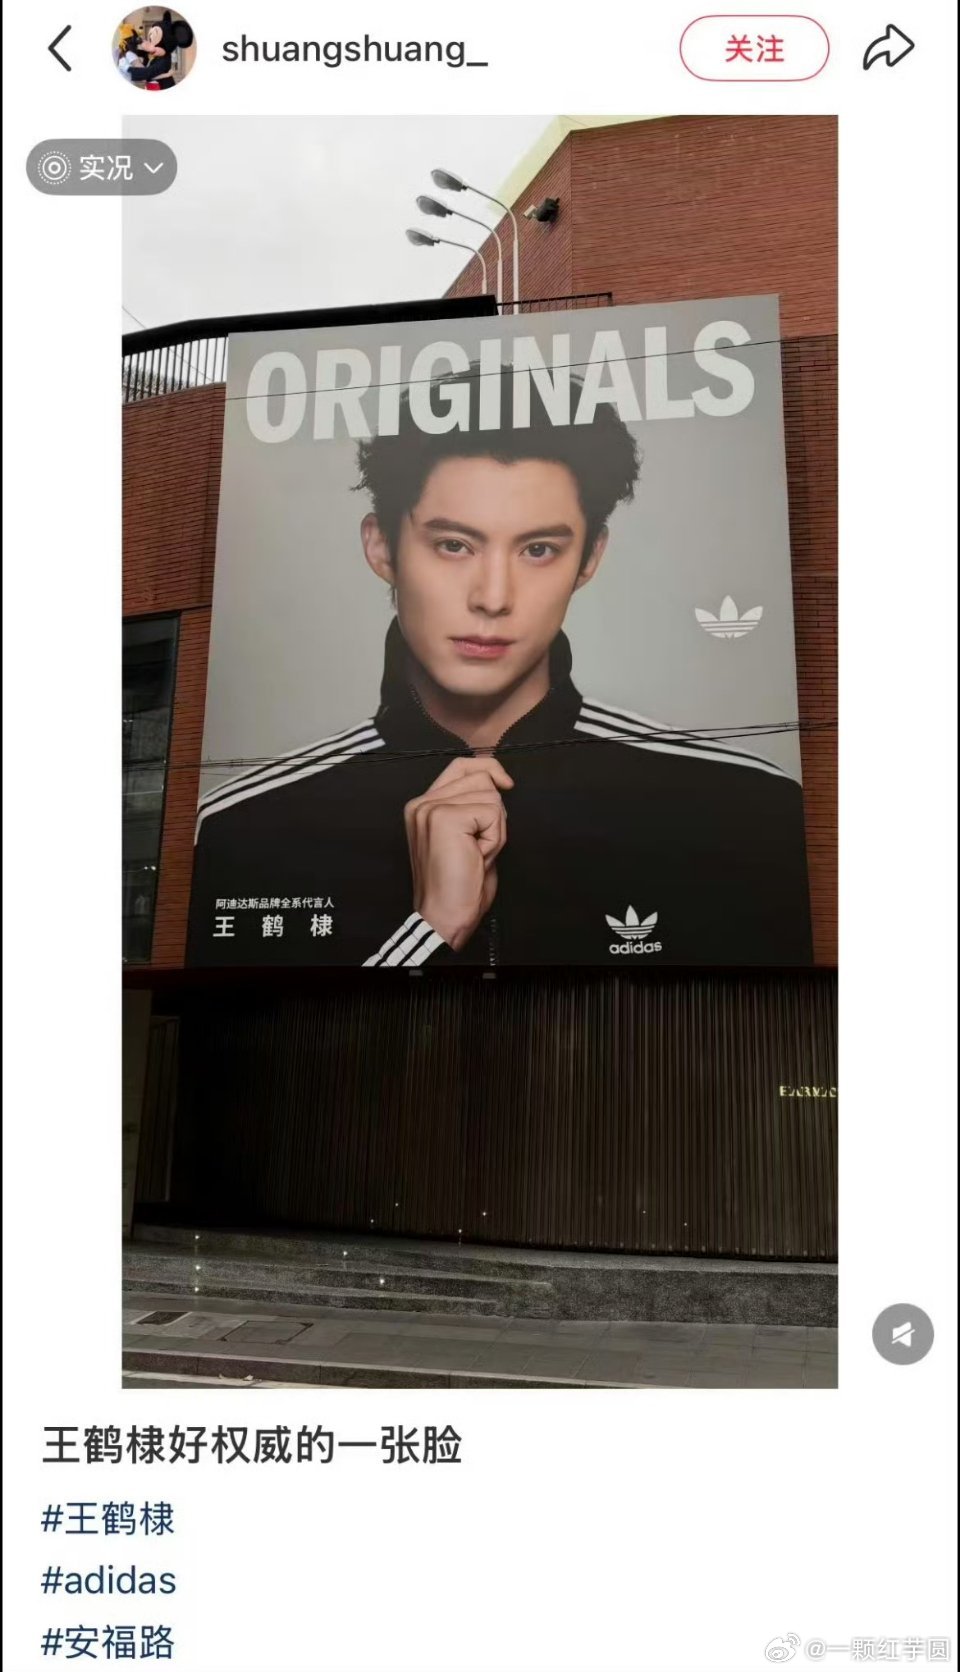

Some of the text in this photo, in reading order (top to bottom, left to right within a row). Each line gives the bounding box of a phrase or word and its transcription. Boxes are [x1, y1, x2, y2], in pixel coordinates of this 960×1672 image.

[245, 320, 755, 444] ORIGINALS
[215, 896, 335, 910] 阿迪达斯品牌全系代言人
[212, 913, 334, 938] 王鹤棣
[608, 940, 663, 955] adidas
